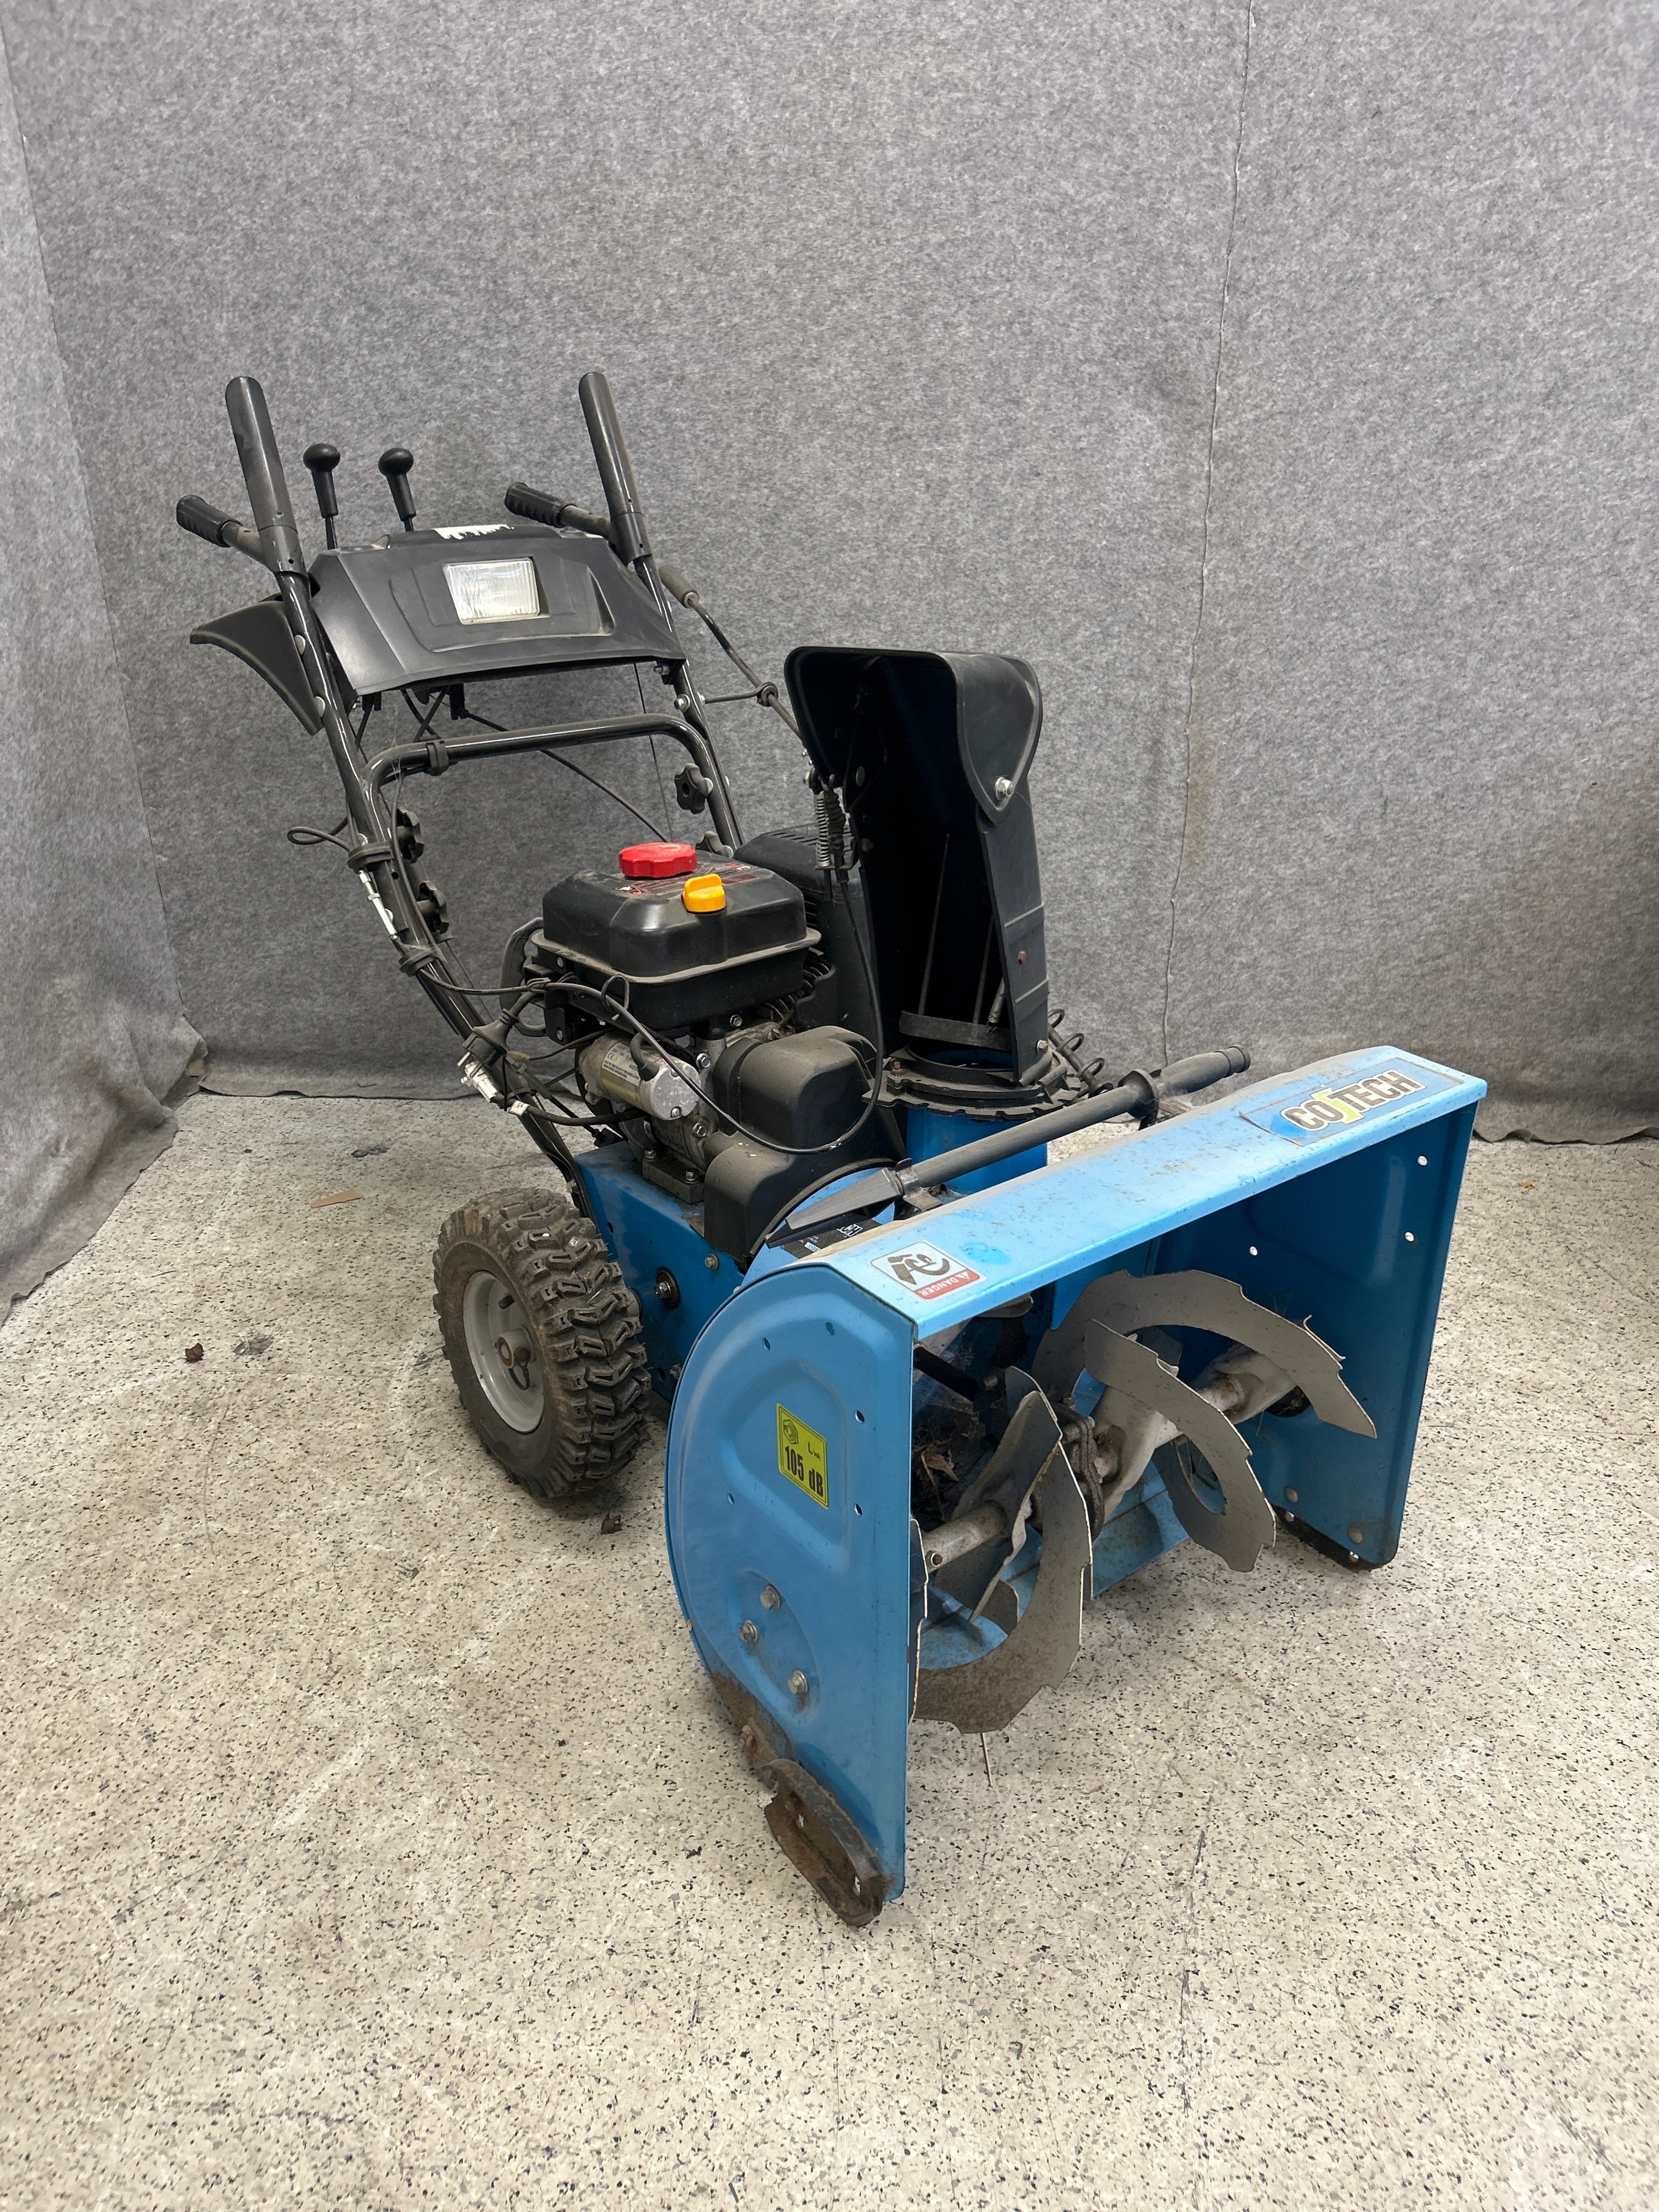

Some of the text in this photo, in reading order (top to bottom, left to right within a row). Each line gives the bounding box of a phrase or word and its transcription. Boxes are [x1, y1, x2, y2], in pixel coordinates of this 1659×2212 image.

[918, 1277, 959, 1296] DANGER
[785, 1446, 823, 1498] 105 dB
